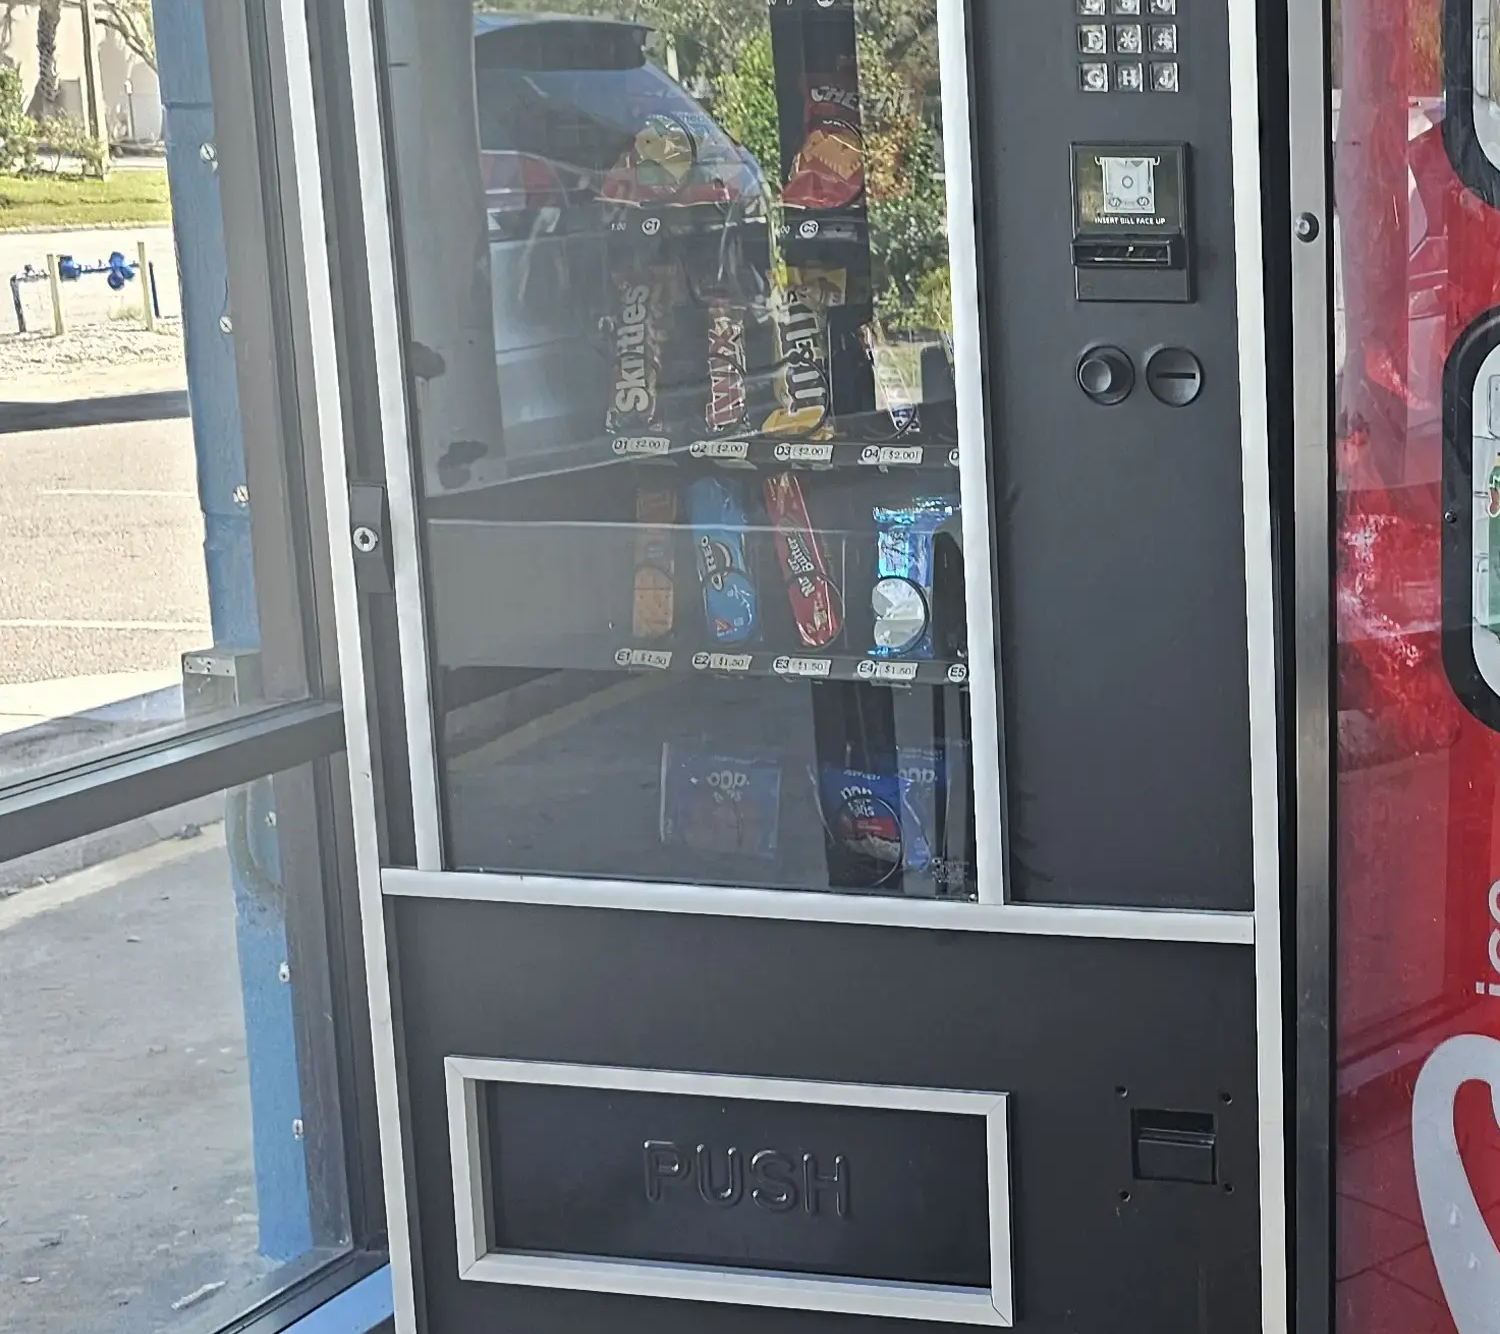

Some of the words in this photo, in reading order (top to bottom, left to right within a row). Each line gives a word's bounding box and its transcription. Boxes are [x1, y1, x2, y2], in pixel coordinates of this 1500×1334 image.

[1088, 71, 1102, 87] G
[1123, 70, 1137, 86] H
[1159, 70, 1171, 86] J
[1095, 216, 1118, 224] INSERT
[1120, 217, 1135, 225] BILL
[1136, 217, 1154, 225] FACE
[645, 221, 657, 232] C1
[802, 223, 817, 234] C3
[614, 440, 628, 449] D1
[691, 444, 707, 453] D2
[777, 446, 790, 456] D3
[864, 448, 879, 458] D4
[788, 537, 815, 572] Butter
[702, 535, 723, 590] OREO
[617, 652, 631, 661] E1
[694, 656, 709, 665] E2
[775, 659, 789, 669] E3
[860, 663, 873, 673] E4
[950, 668, 965, 678] E5
[645, 1140, 852, 1217] PUSH
